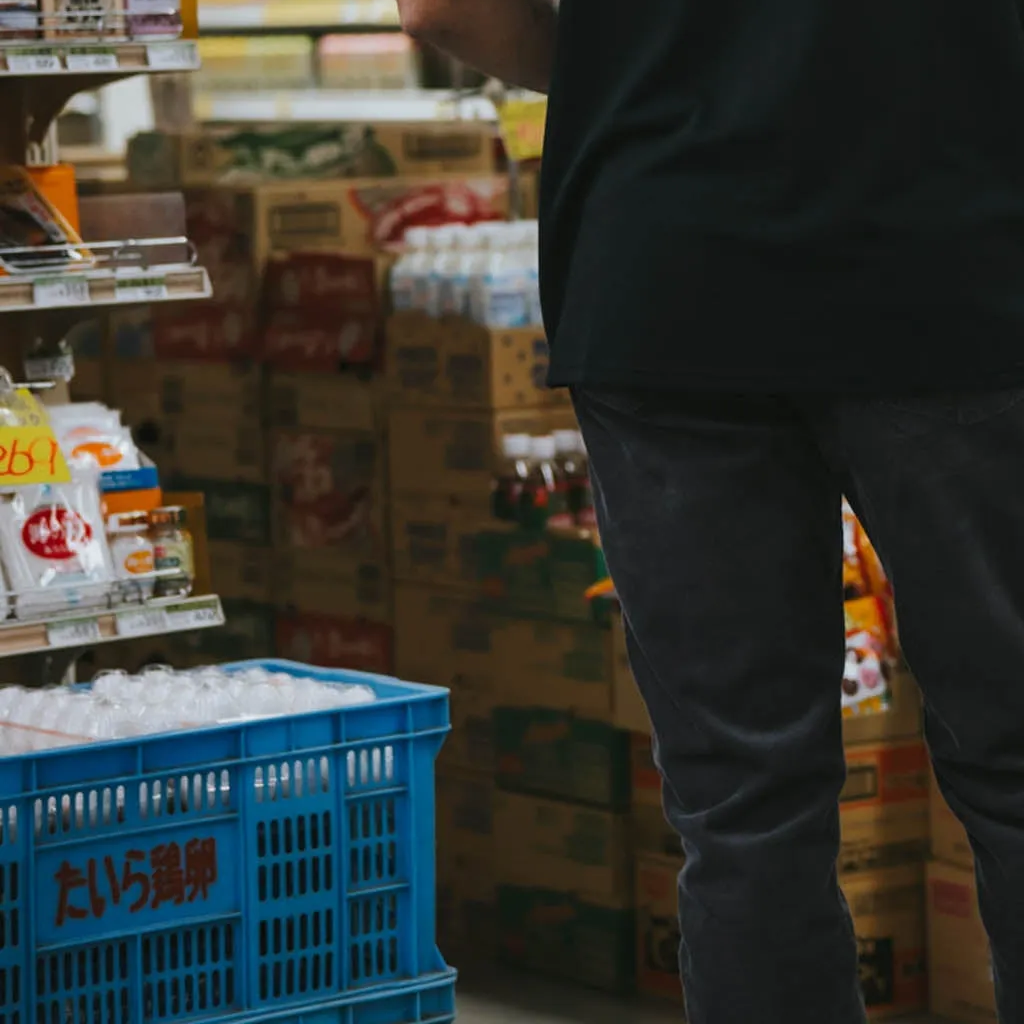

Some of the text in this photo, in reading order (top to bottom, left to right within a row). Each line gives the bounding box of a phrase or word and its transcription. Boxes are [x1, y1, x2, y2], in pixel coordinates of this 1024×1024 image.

[53, 836, 218, 927] たいら鶏卵
